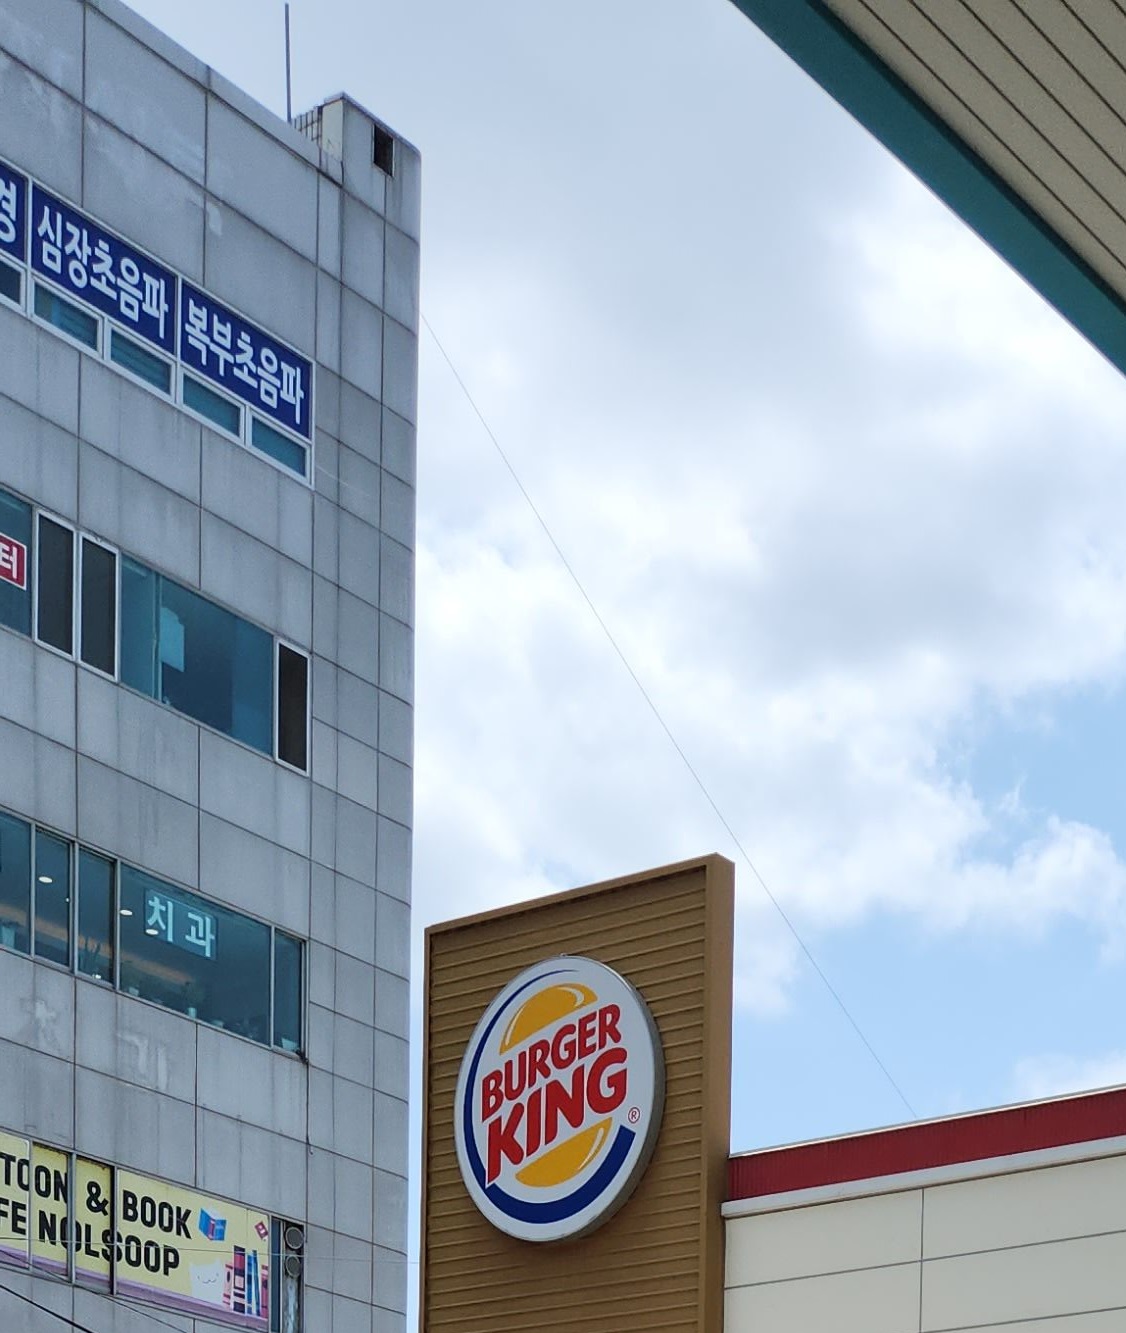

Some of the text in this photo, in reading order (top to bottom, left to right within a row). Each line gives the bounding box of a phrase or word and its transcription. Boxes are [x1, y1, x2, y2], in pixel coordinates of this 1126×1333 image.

[38, 206, 169, 339] 심장초음파
[185, 298, 304, 425] 복부초음파
[147, 895, 215, 958] 치과
[481, 1003, 622, 1123] BURGER
[485, 1047, 628, 1185] KING
[38, 1209, 180, 1276] NOLSOOP
[86, 1180, 109, 1216] &
[122, 1189, 193, 1240] BOOK
